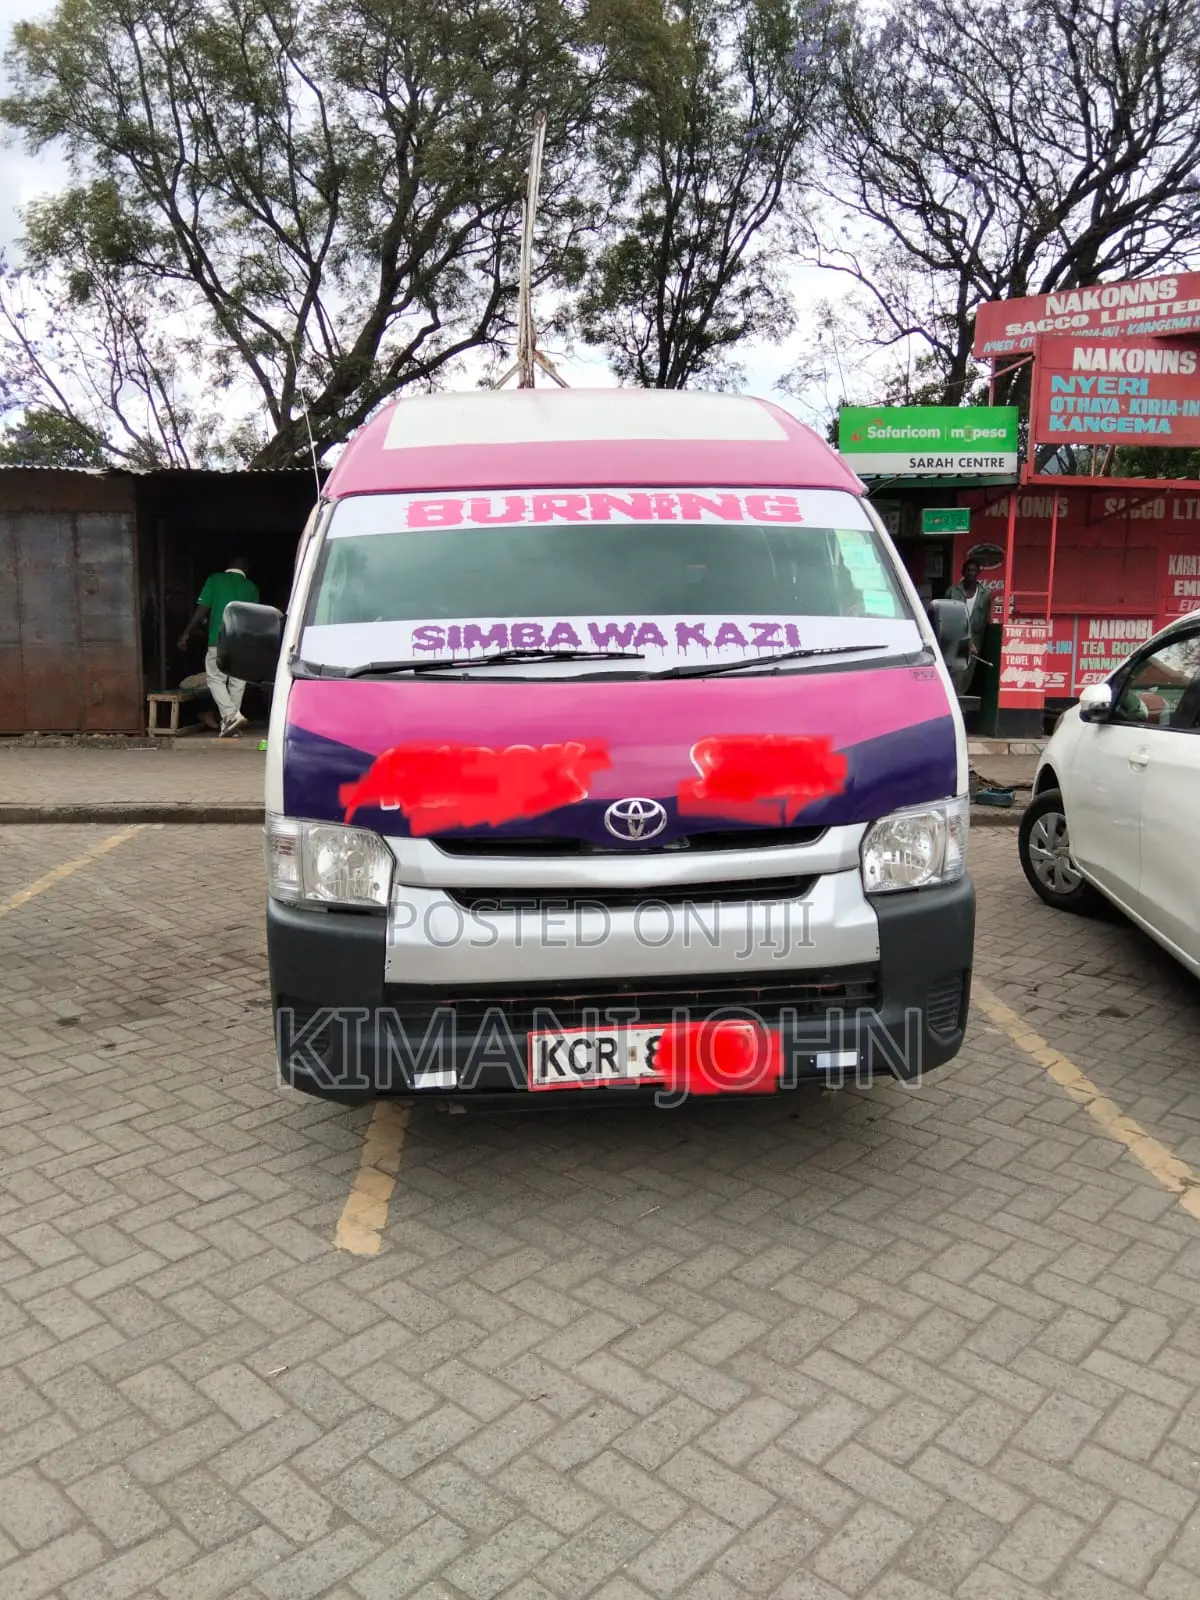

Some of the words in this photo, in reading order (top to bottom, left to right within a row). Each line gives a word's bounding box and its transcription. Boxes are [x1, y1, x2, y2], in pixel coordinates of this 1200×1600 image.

[1045, 278, 1178, 316] NAKONNS
[1005, 314, 1090, 336] SACCO
[1100, 298, 1200, 324] LIMITED
[1126, 318, 1192, 335] KANGEMA
[1072, 347, 1197, 375] NAKONNS
[1051, 375, 1149, 395] NYERI
[1050, 396, 1120, 414] OTHAYA
[868, 425, 940, 439] Safaricom
[1049, 416, 1172, 434] KANGEMA
[909, 457, 953, 468] SARAH
[958, 457, 1005, 468] CENTRE
[404, 493, 803, 527] BURNING
[1089, 619, 1154, 639] NAIROBI
[412, 621, 582, 658] SIMBA
[588, 621, 669, 655] WA
[675, 622, 800, 657] KAZI
[1081, 641, 1105, 655] TEA
[1006, 655, 1029, 665] TRAVEL
[1033, 656, 1042, 666] IN
[539, 1036, 620, 1078] KCR
